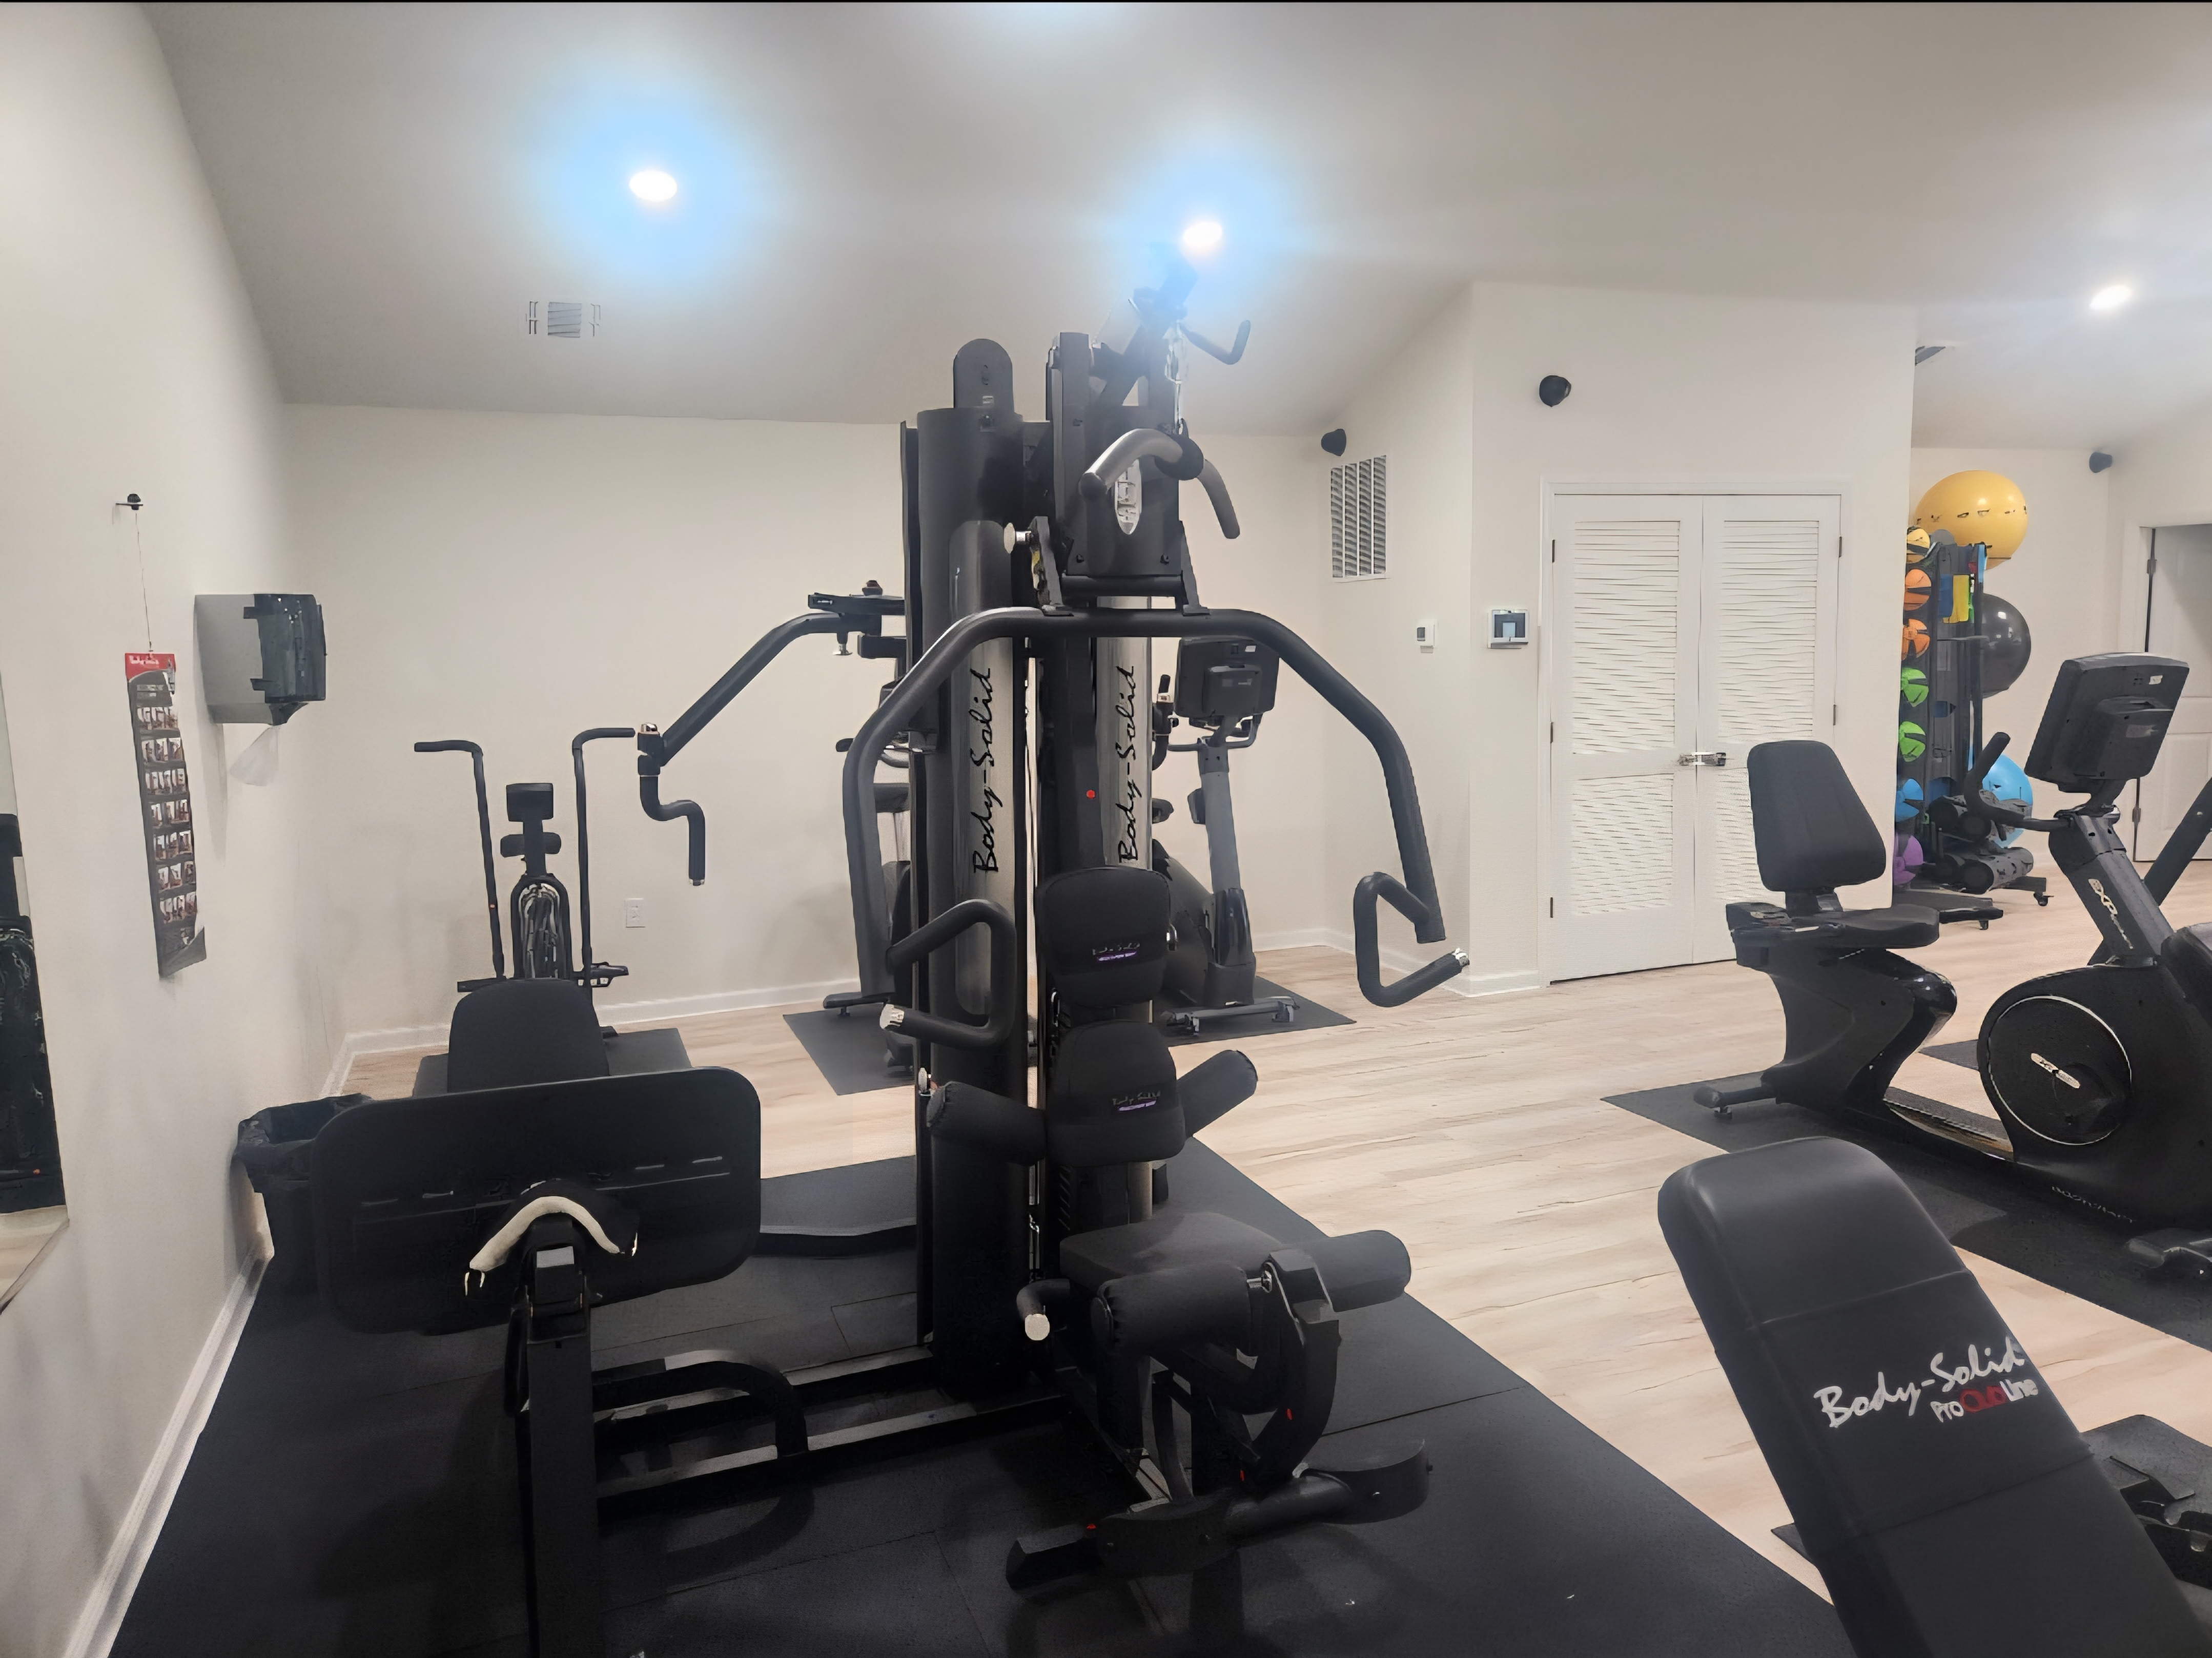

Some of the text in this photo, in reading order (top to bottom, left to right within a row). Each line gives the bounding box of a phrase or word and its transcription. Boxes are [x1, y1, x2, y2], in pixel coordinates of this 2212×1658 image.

[969, 668, 1003, 873] Body-Solid
[1115, 666, 1142, 863] Body-Solid
[1813, 1336, 2025, 1428] Body-Solid
